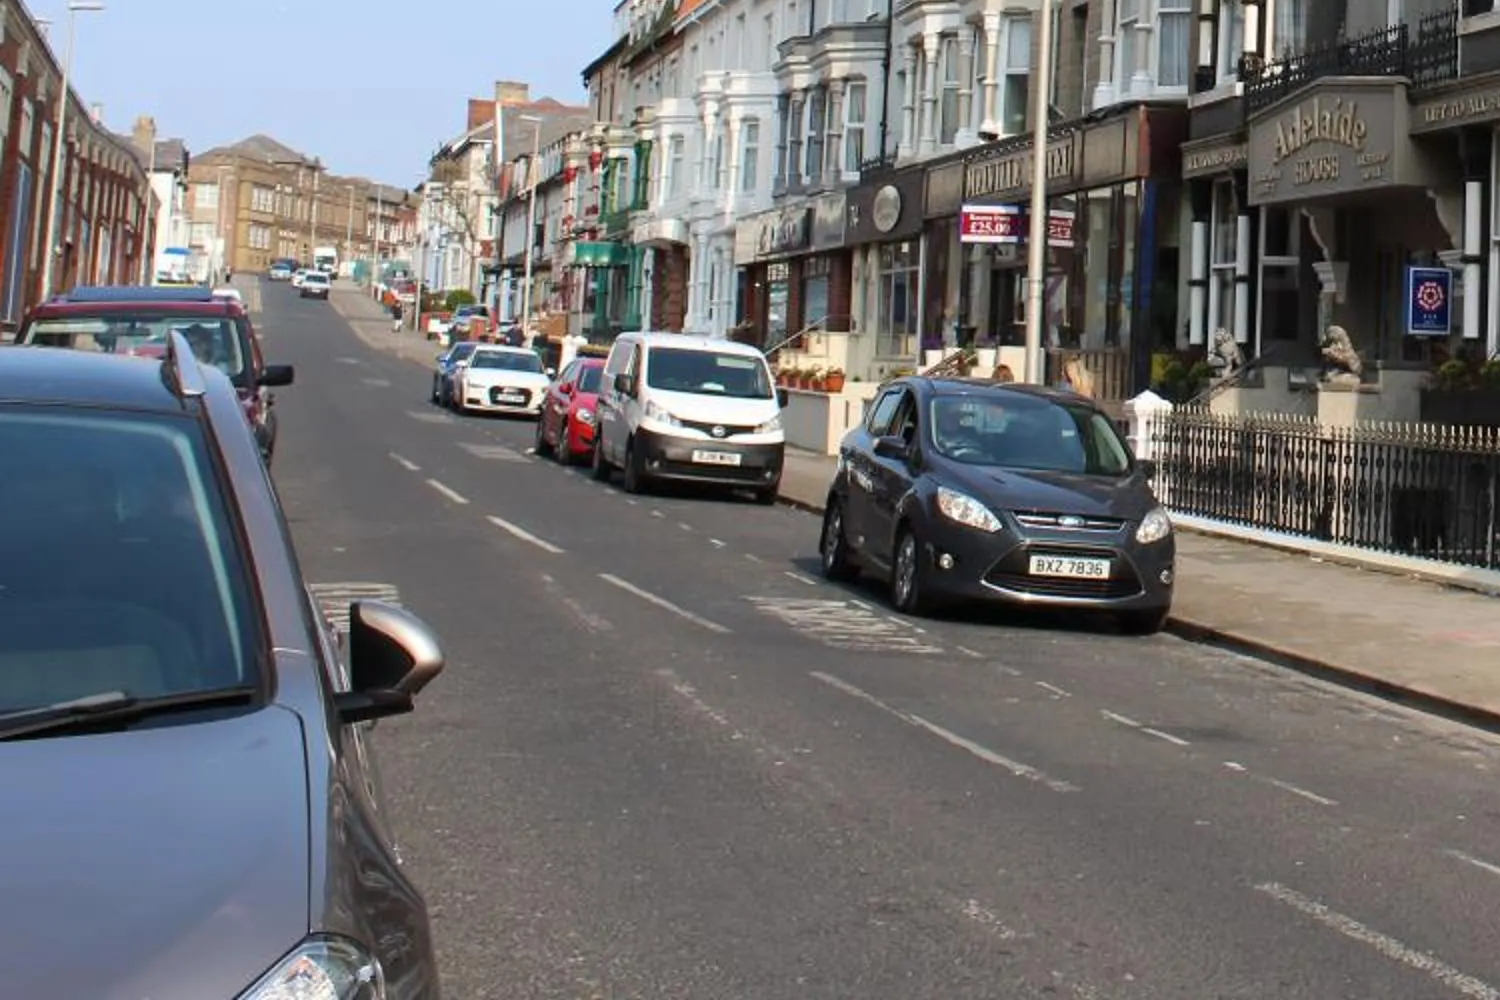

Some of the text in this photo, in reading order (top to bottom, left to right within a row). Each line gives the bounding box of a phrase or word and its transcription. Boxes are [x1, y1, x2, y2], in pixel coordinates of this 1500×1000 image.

[1273, 96, 1367, 164] Adelaide
[965, 158, 1022, 199] MELVILLE
[1294, 153, 1340, 184] HOUSE
[1035, 559, 1104, 575] BXZ 7836
